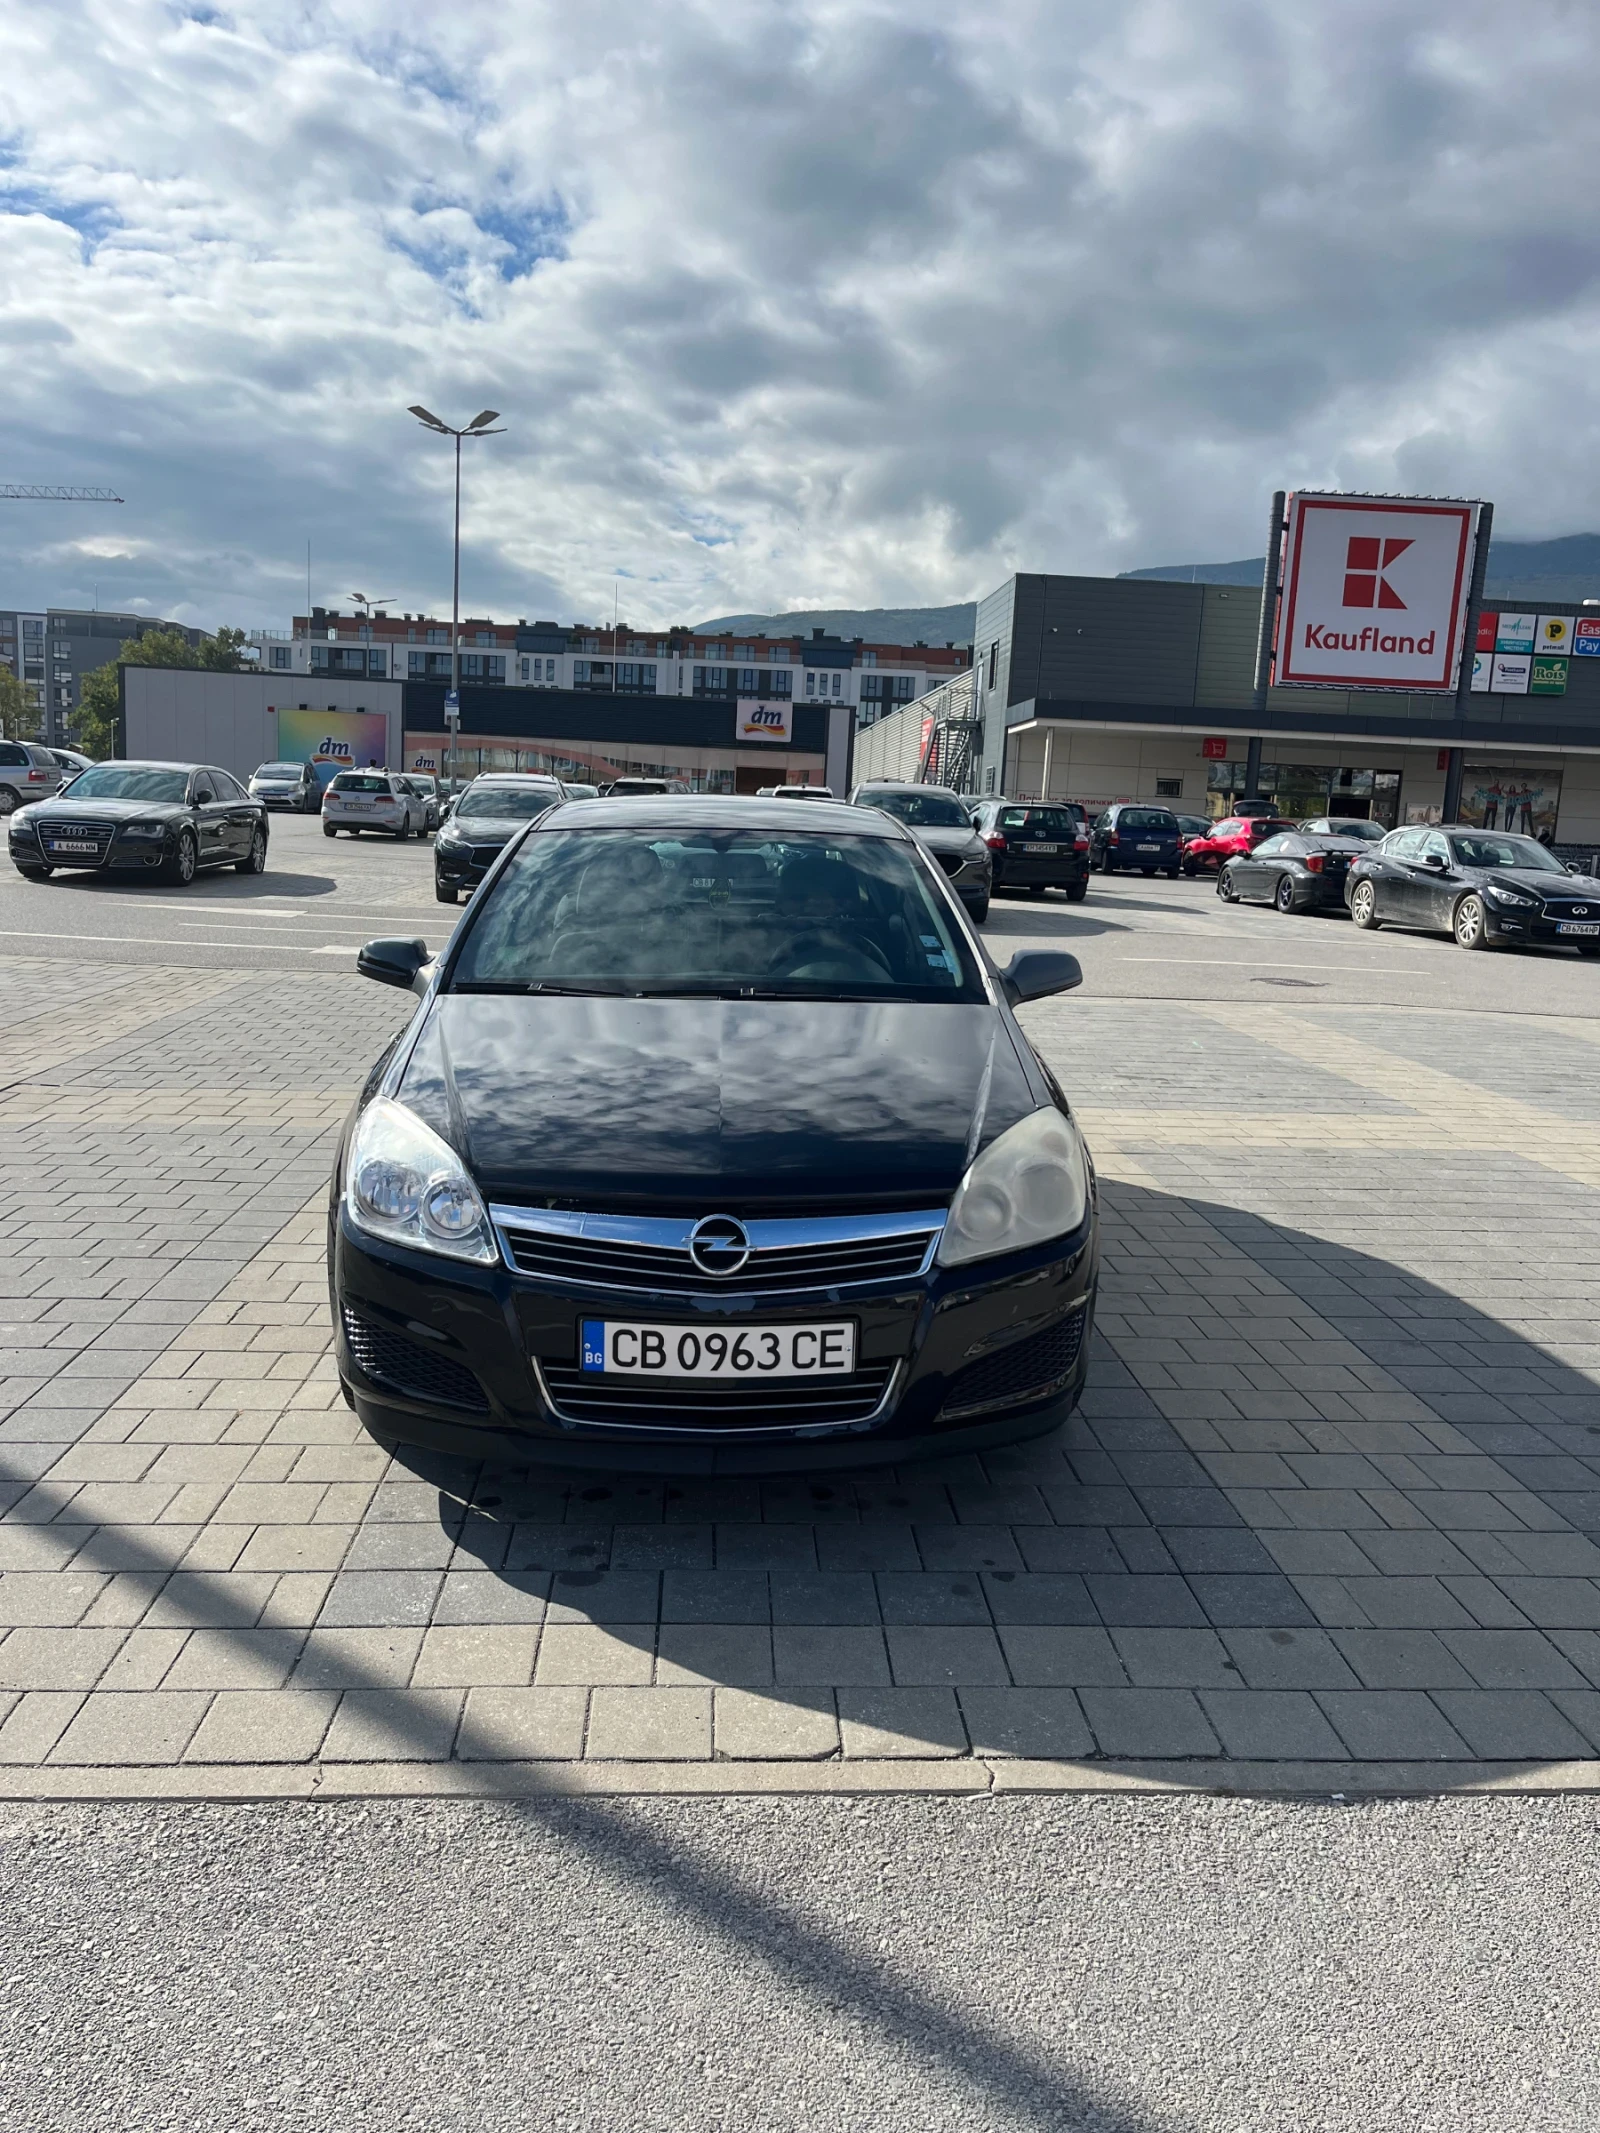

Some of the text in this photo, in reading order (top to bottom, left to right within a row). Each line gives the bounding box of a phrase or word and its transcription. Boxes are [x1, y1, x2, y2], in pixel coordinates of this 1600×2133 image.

[1580, 623, 1600, 635] Eas
[1304, 623, 1436, 655] Kaufland
[1578, 638, 1600, 653] Pay
[1534, 666, 1566, 681] Rois
[751, 705, 783, 725] dm
[318, 737, 350, 756] dm
[415, 755, 435, 768] dm
[66, 842, 85, 851] 6666
[1561, 924, 1571, 932] CB
[1572, 925, 1589, 934] 6764
[585, 1328, 845, 1372] BG CB 0963 CE
